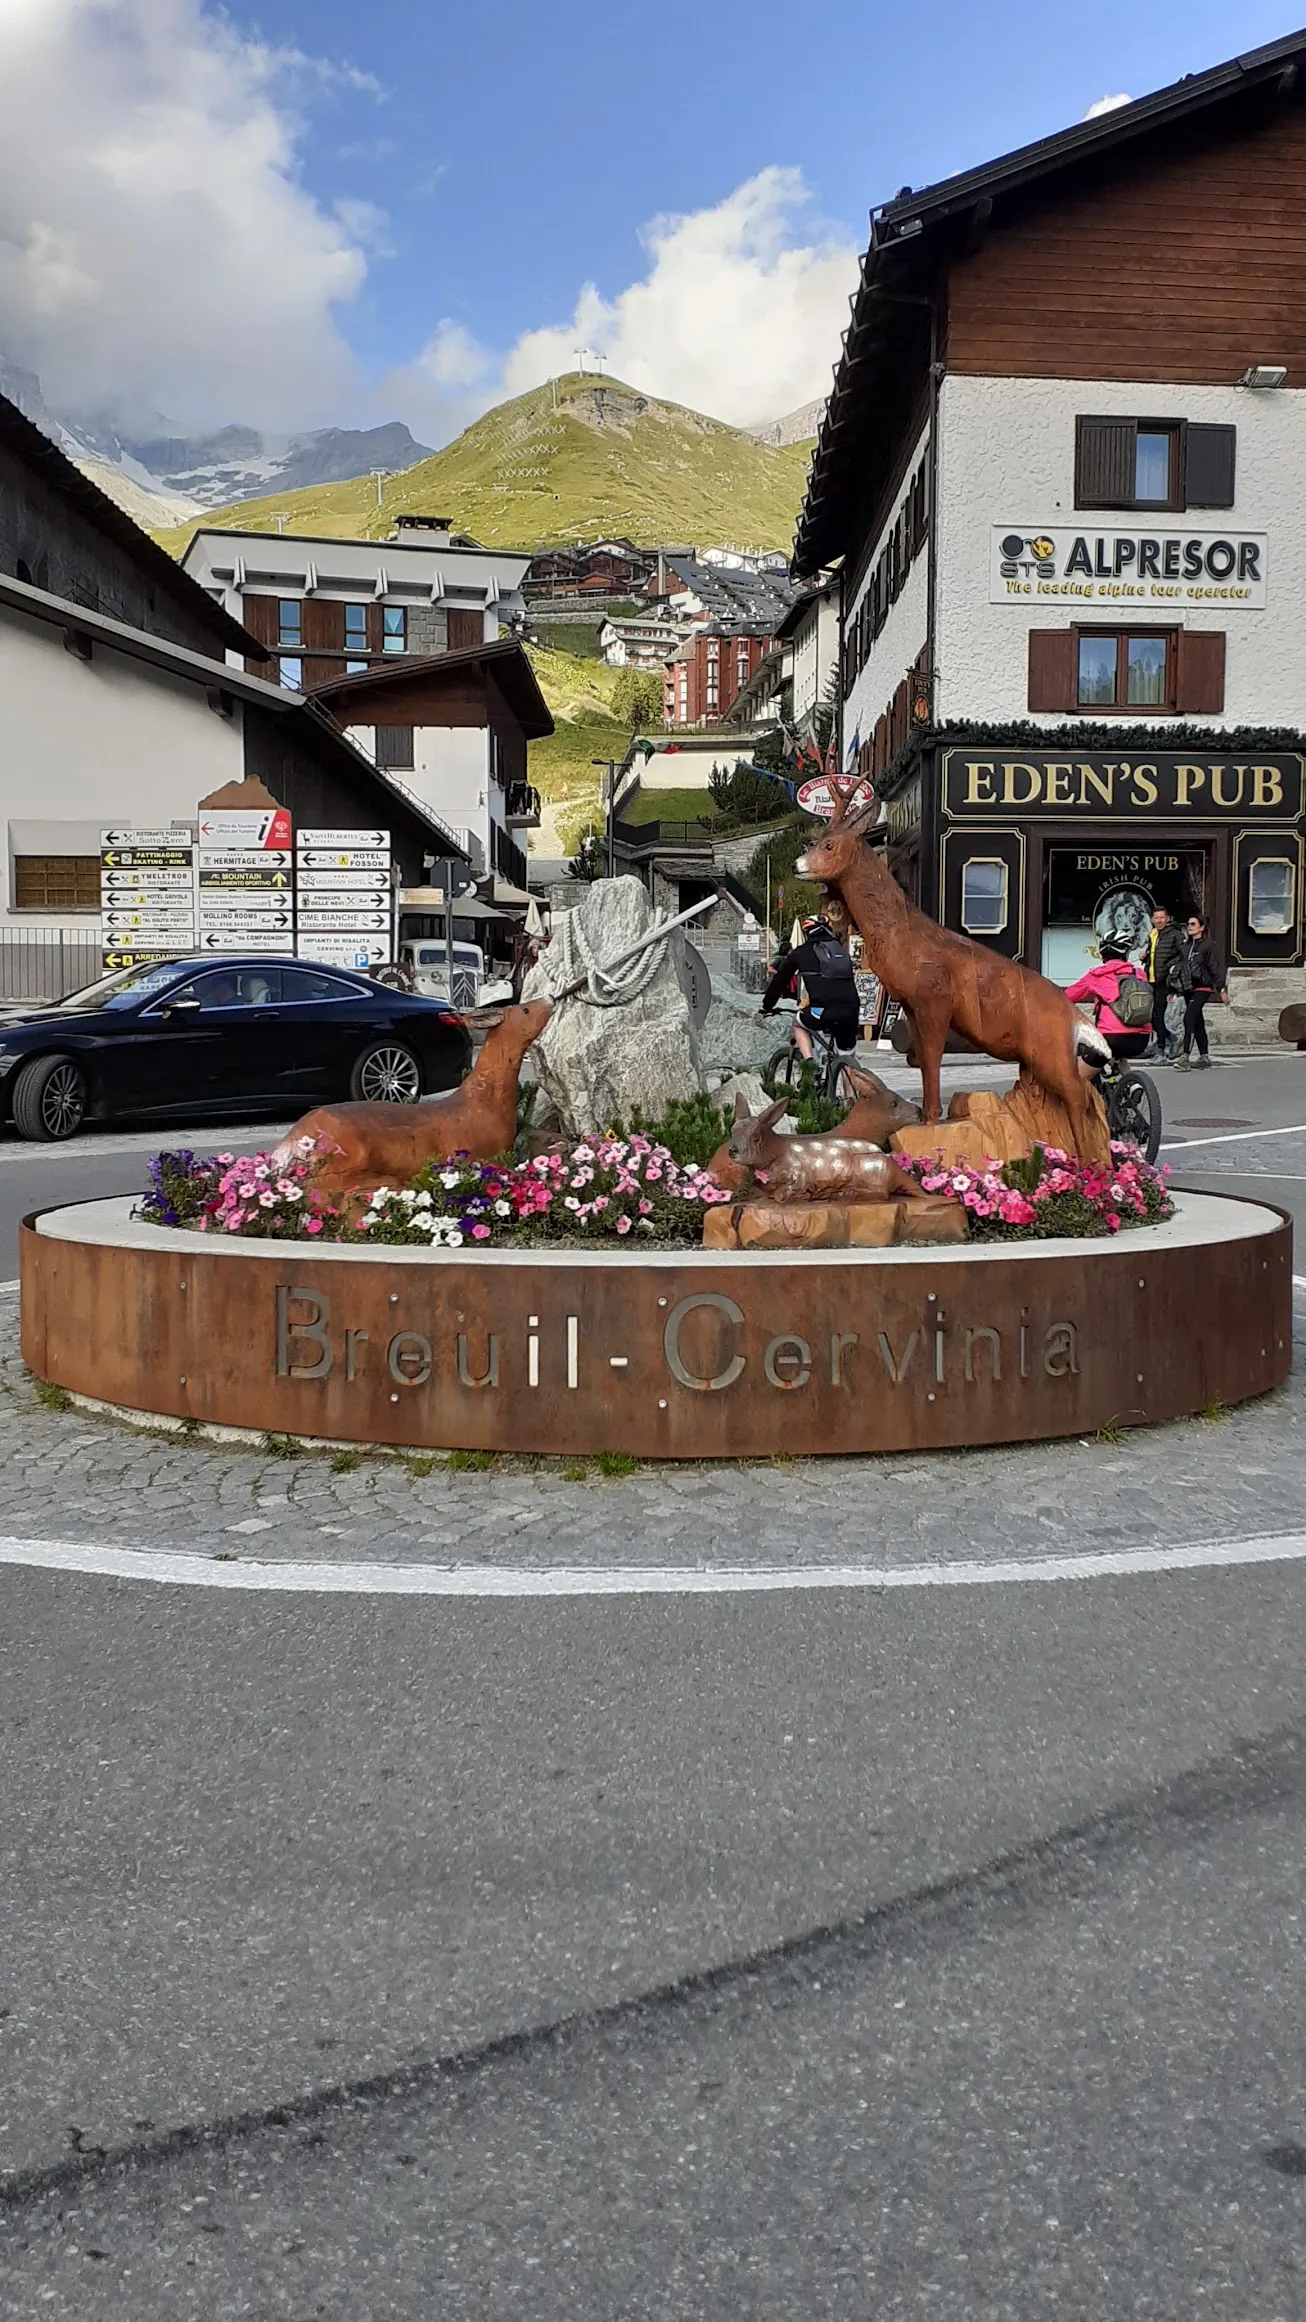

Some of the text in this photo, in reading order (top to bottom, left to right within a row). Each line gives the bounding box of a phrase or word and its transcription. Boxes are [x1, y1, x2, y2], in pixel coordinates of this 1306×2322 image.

[1064, 536, 1261, 580] ALPRESOR
[1000, 560, 1055, 577] STS
[1006, 581, 1252, 599] The leading alpine tour operator
[962, 761, 1283, 806] EDEN'S PUB
[213, 857, 257, 865] HERMITAGE
[1076, 856, 1179, 871] EDEN'S PUB
[221, 872, 262, 880] MOUNTAIN
[1098, 874, 1154, 893] IRISH PUB
[356, 954, 367, 966] P
